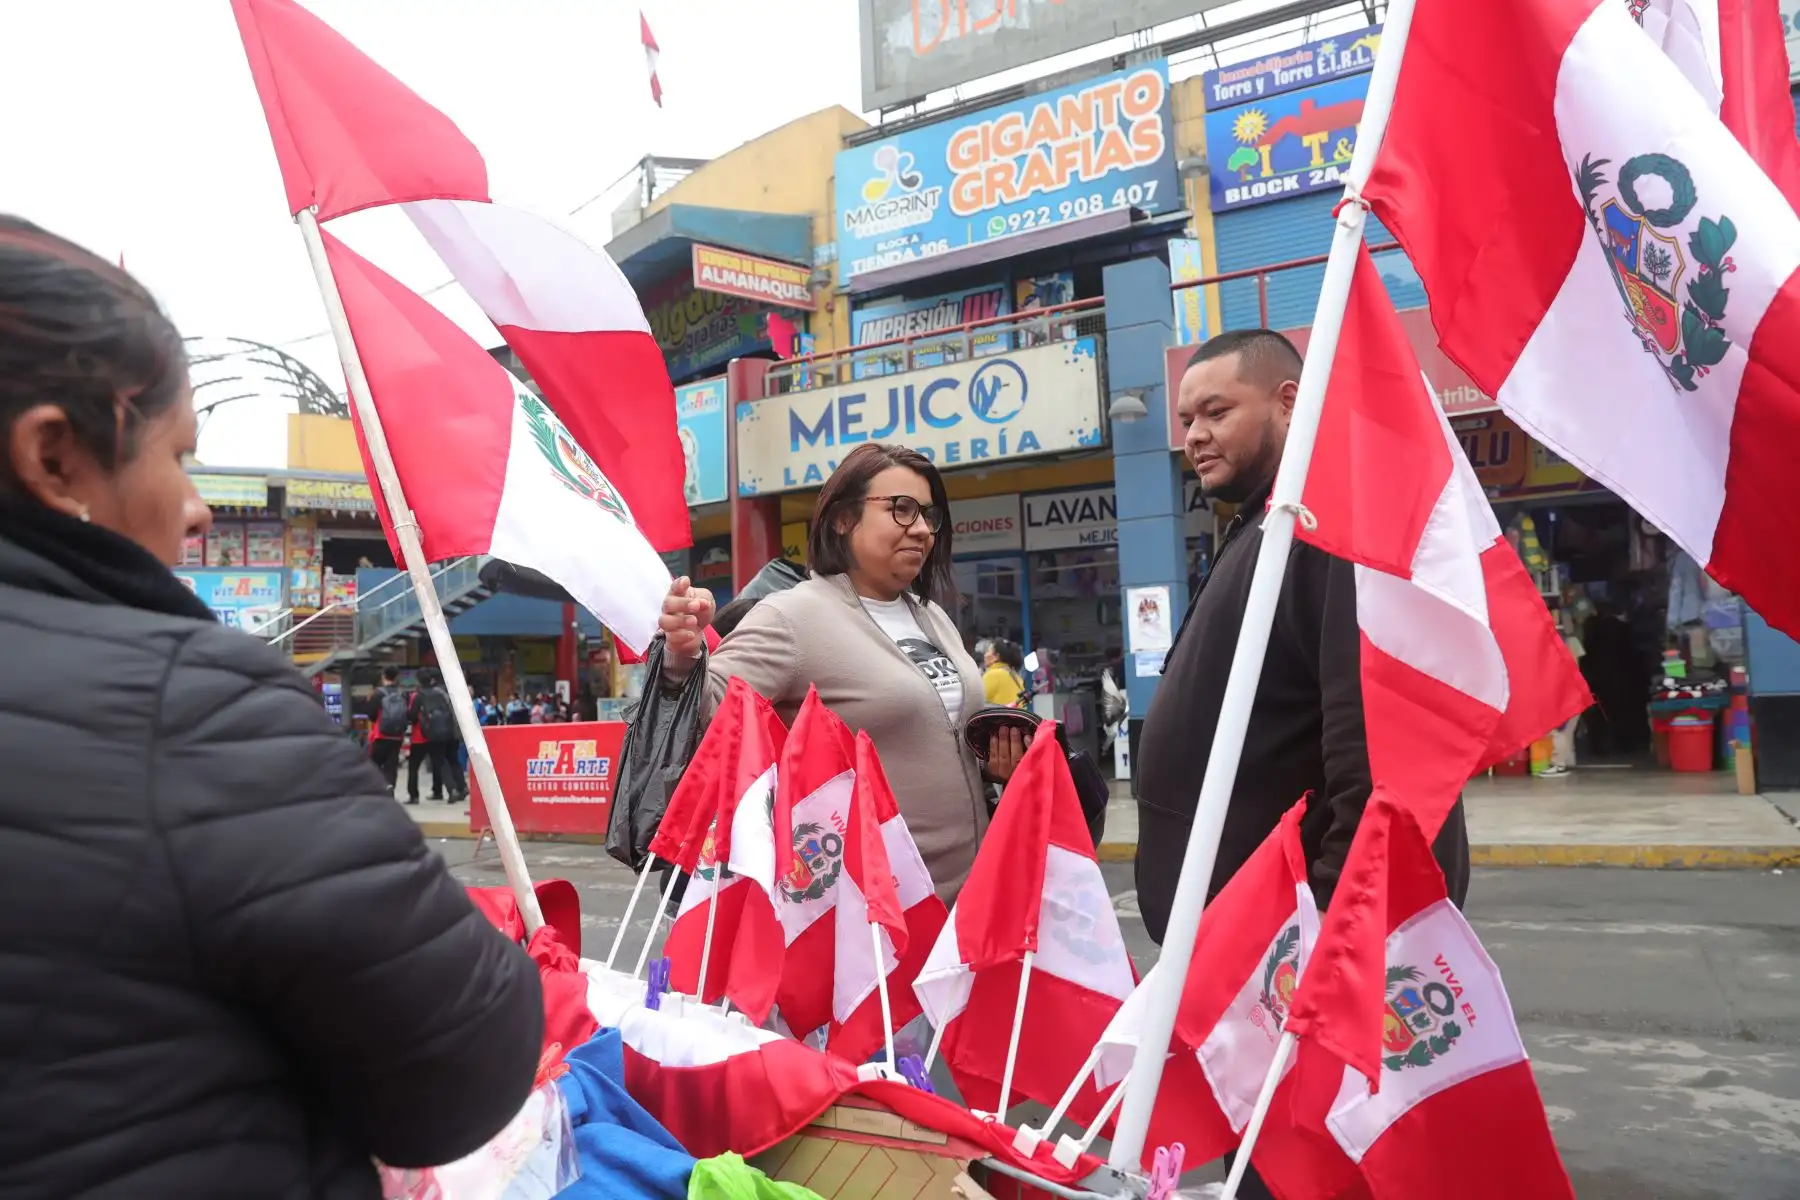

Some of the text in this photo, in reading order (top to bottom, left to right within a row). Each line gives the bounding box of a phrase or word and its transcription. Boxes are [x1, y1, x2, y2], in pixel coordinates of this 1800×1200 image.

[1213, 79, 1252, 101] Torre
[1256, 77, 1264, 94] y
[1272, 64, 1314, 86] Torre
[947, 70, 1163, 171] GIGANTO
[950, 117, 1163, 214] GRAFIAS
[1008, 180, 1159, 232] 922 908 407
[1225, 174, 1300, 204] BLOCK
[846, 189, 940, 228] MACPRINT
[852, 239, 948, 272] TIENDA 106
[876, 233, 920, 251] BLOCK A
[702, 265, 812, 301] ALMANAQUES
[860, 299, 963, 345] IMPRESIÓN
[789, 358, 1028, 453] MEJICO
[783, 429, 1043, 487] LADERÍA
[1079, 528, 1118, 545] MEJIC
[527, 745, 609, 775] VITARTE
[527, 781, 610, 792] CENTRO COMERCIAL
[1433, 953, 1478, 1029] VIVA EL
